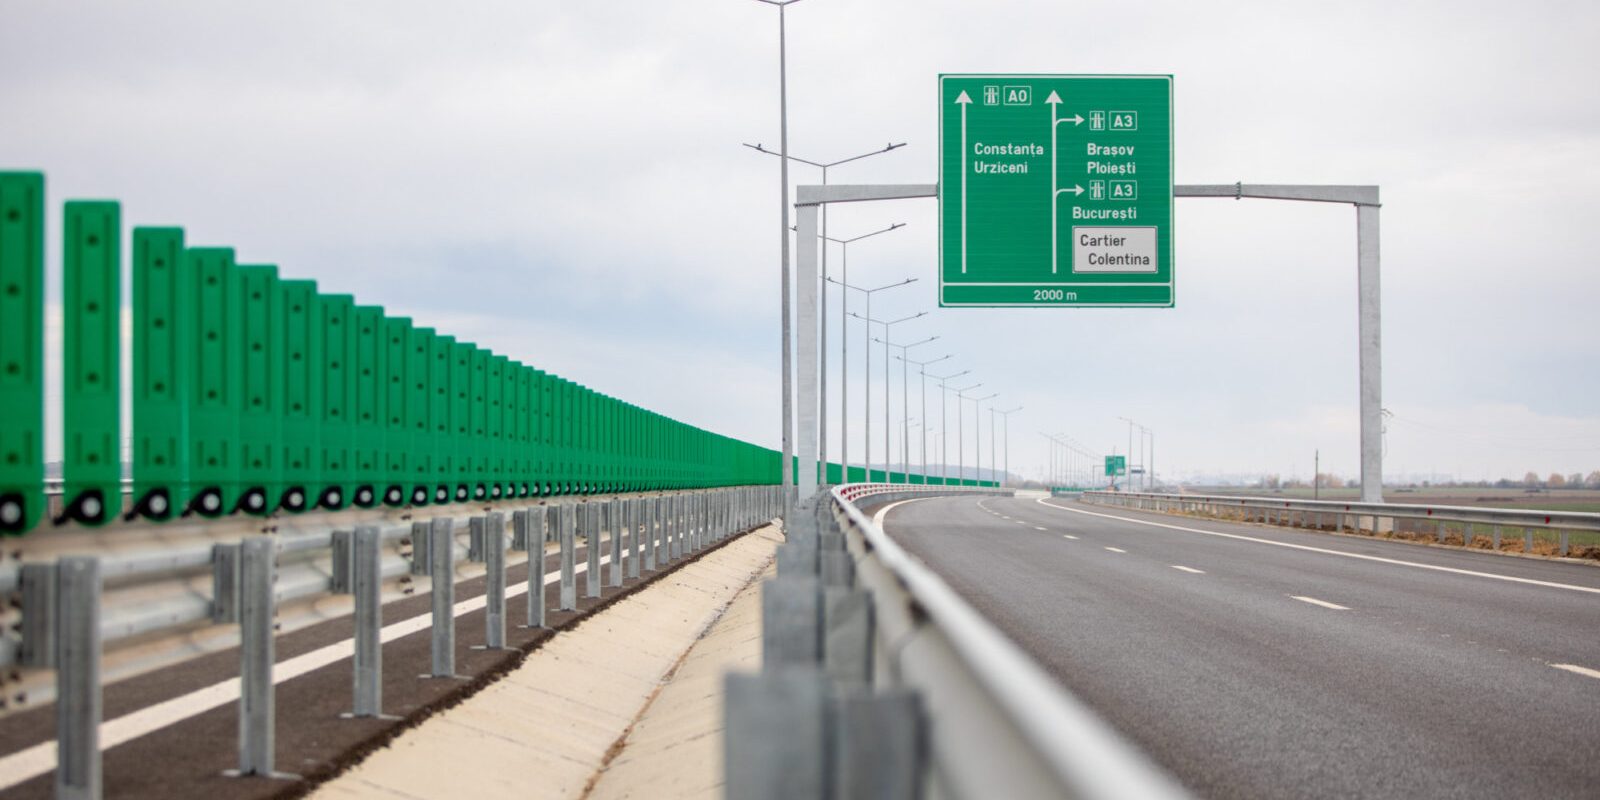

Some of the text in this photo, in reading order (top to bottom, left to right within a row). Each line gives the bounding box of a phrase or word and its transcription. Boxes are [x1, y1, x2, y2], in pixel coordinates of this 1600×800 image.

[1008, 89, 1027, 102] A0
[1114, 114, 1133, 127] A3
[974, 142, 1044, 158] Constanța
[1087, 142, 1135, 159] Brașov
[974, 161, 1028, 174] Urziceni
[1087, 161, 1136, 177] Ploiești
[1114, 184, 1133, 197] A3
[1072, 206, 1137, 222] București
[1080, 234, 1127, 247] Cartier
[1088, 252, 1150, 266] Colentina
[1034, 289, 1077, 301] 2000 m
